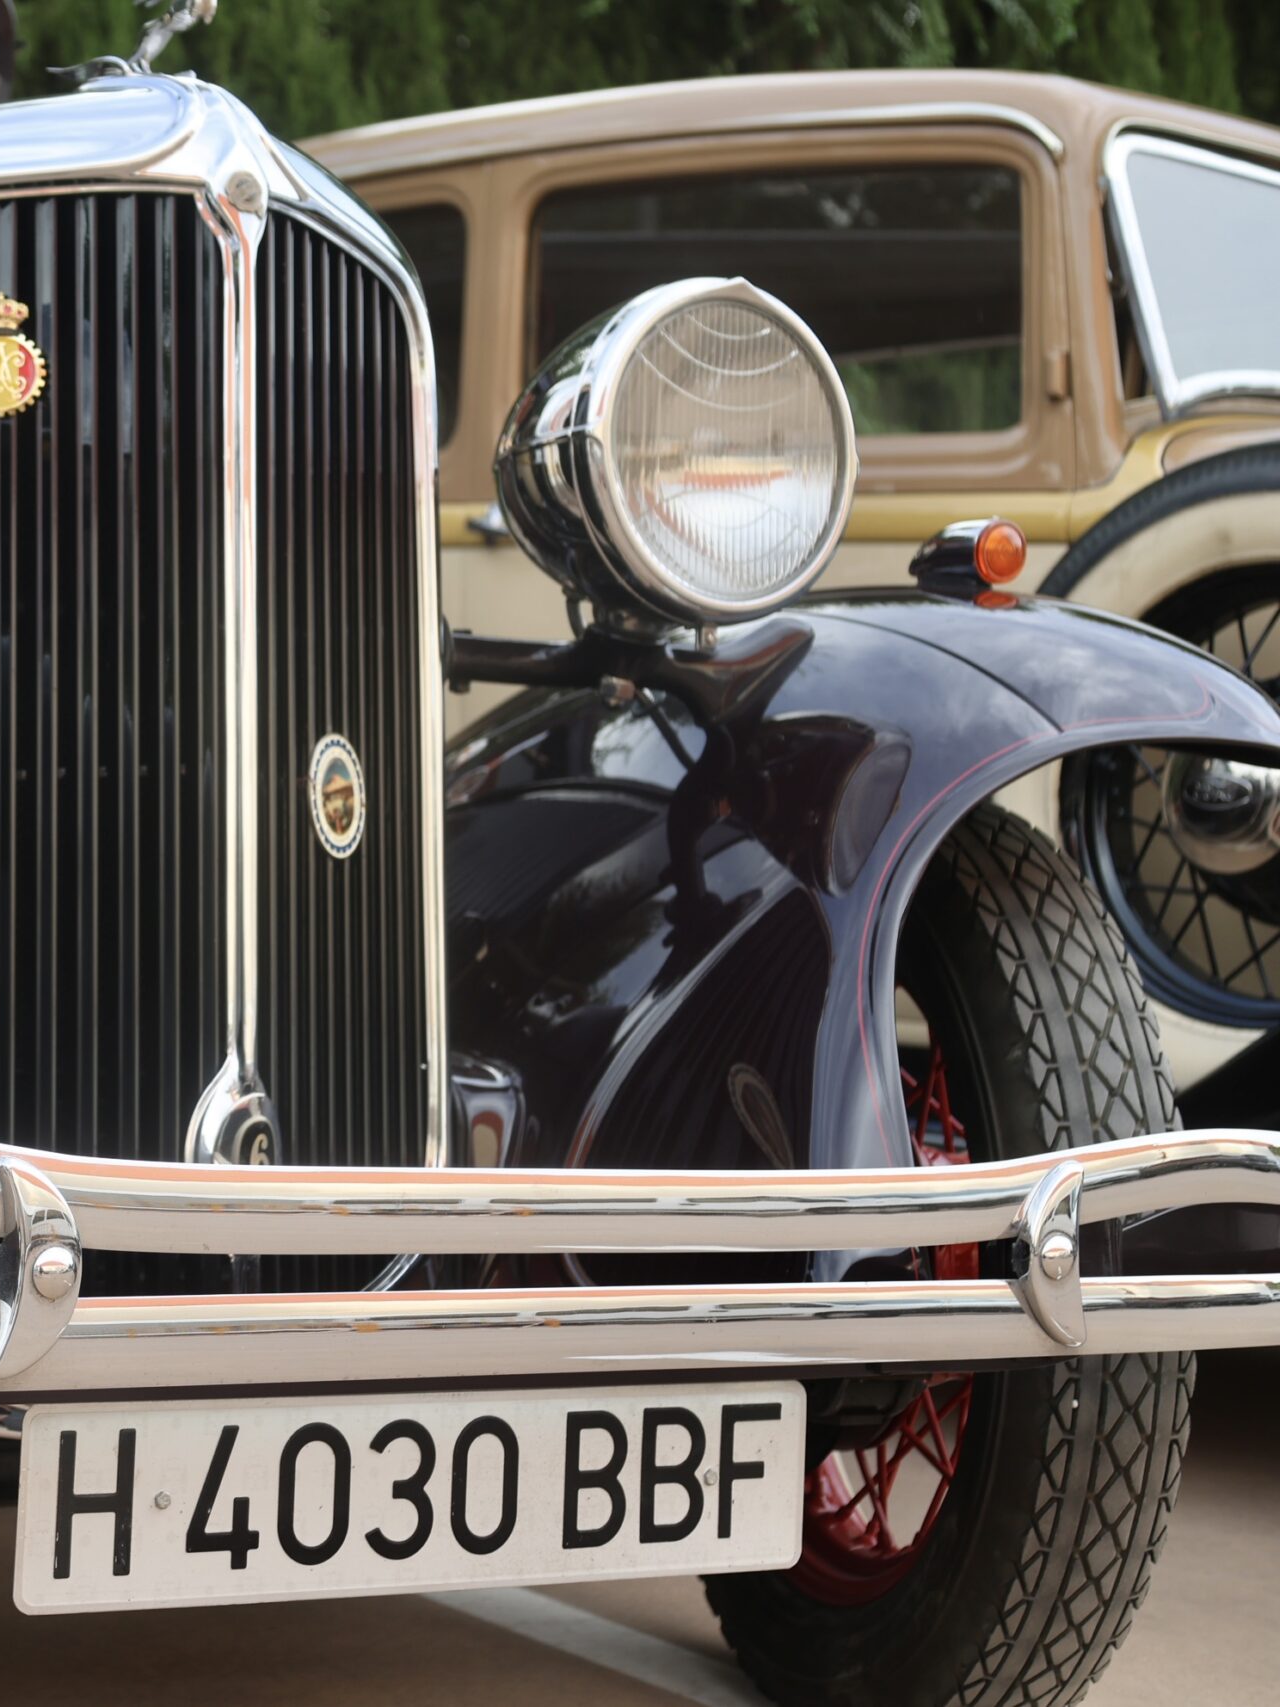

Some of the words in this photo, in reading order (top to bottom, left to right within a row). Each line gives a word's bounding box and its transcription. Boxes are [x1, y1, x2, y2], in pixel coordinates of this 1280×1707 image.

[52, 1427, 138, 1580] H
[184, 1415, 520, 1572] 4030
[561, 1401, 783, 1550] BBF
